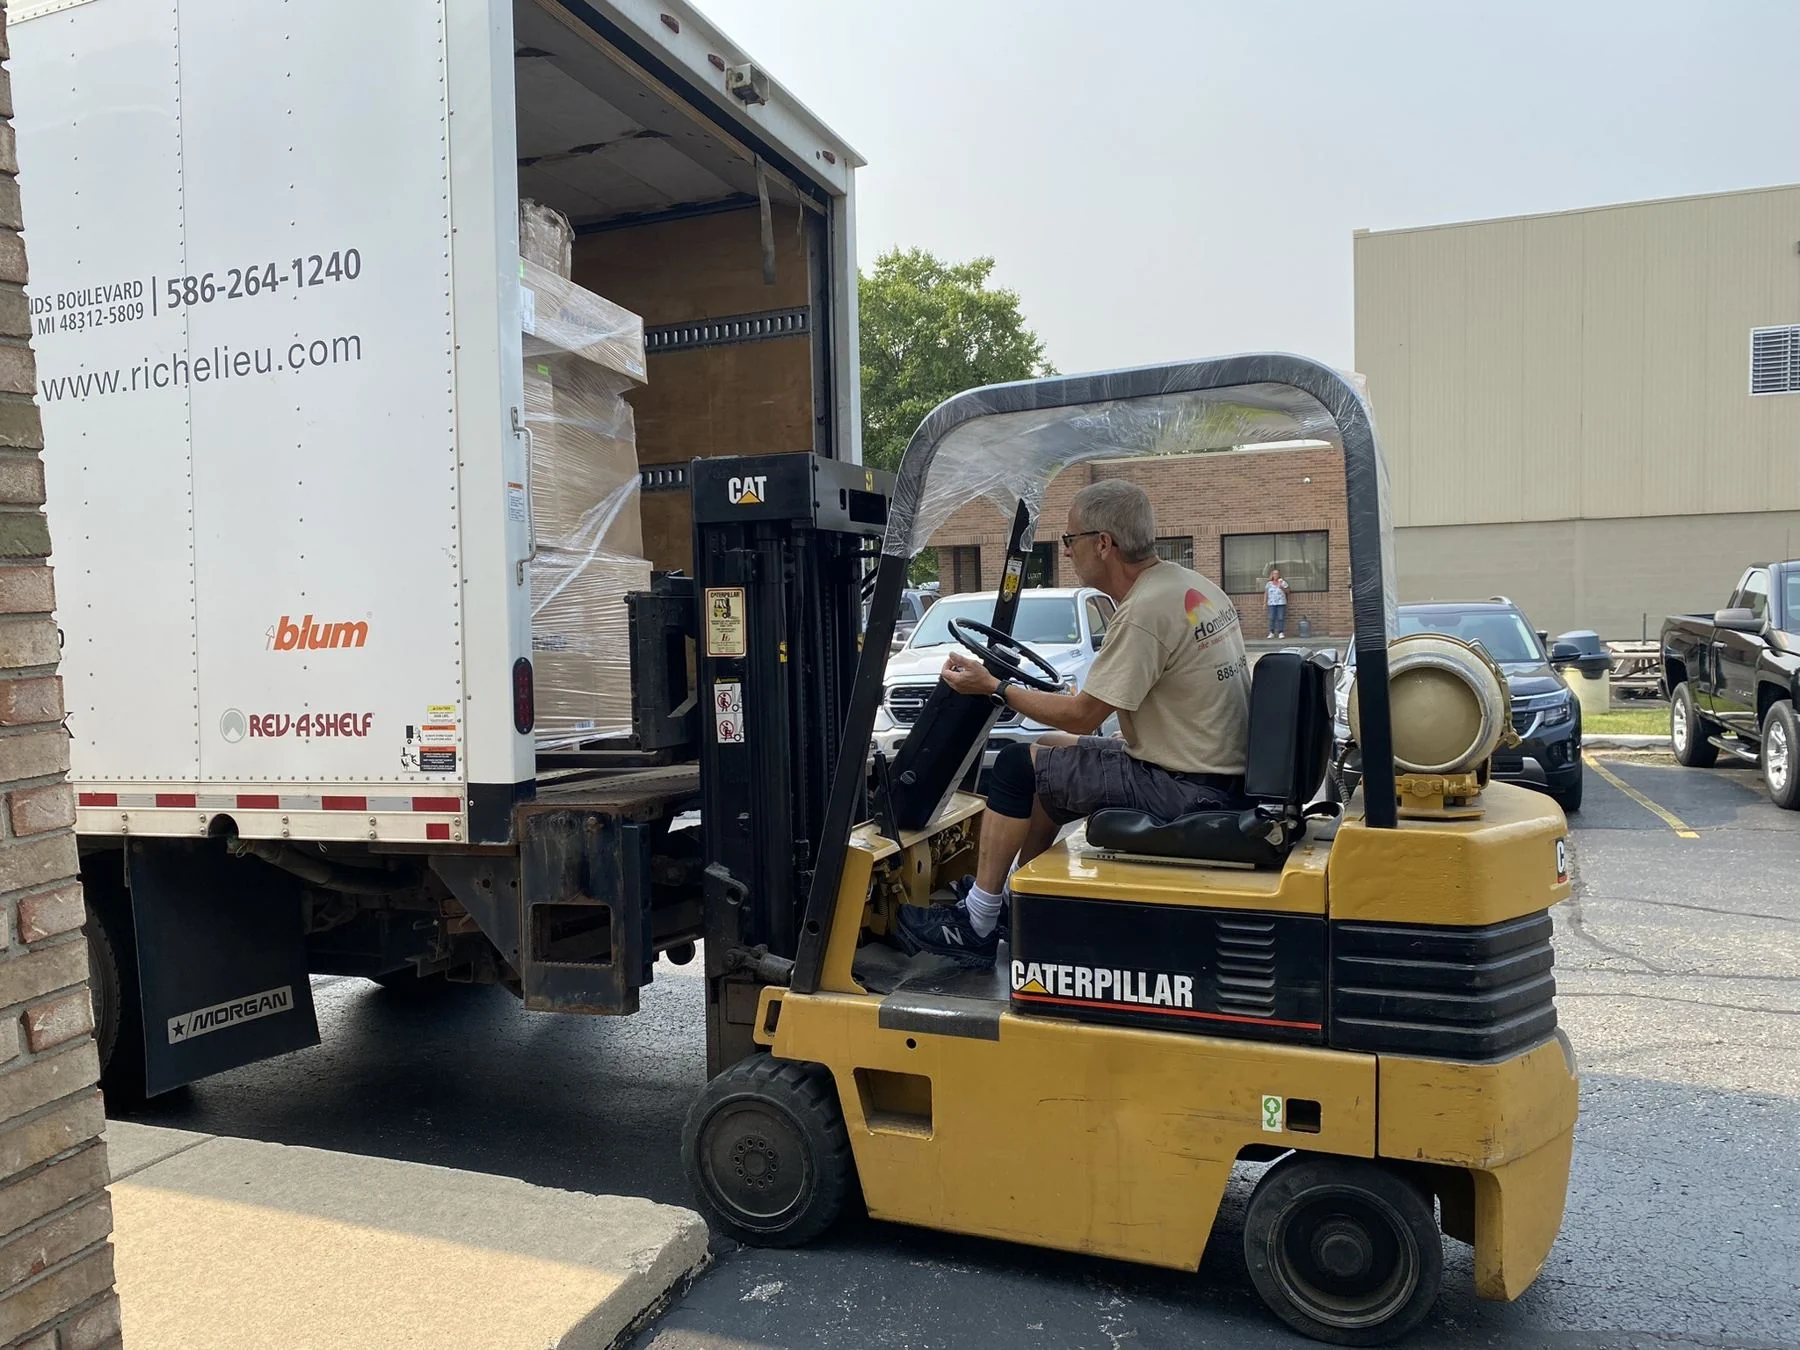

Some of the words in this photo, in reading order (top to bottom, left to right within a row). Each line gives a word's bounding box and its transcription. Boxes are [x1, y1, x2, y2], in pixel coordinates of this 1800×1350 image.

[57, 280, 144, 311] BOULEVARD
[166, 248, 361, 309] 586-264-1240
[38, 316, 55, 335] MI
[60, 302, 145, 332] 48312-5809
[42, 334, 362, 402] www.richelieu.com
[728, 475, 767, 504] CAT
[273, 614, 368, 651] blum
[1011, 959, 1194, 1008] CATERPILLAR
[193, 992, 288, 1032] MORGAN
